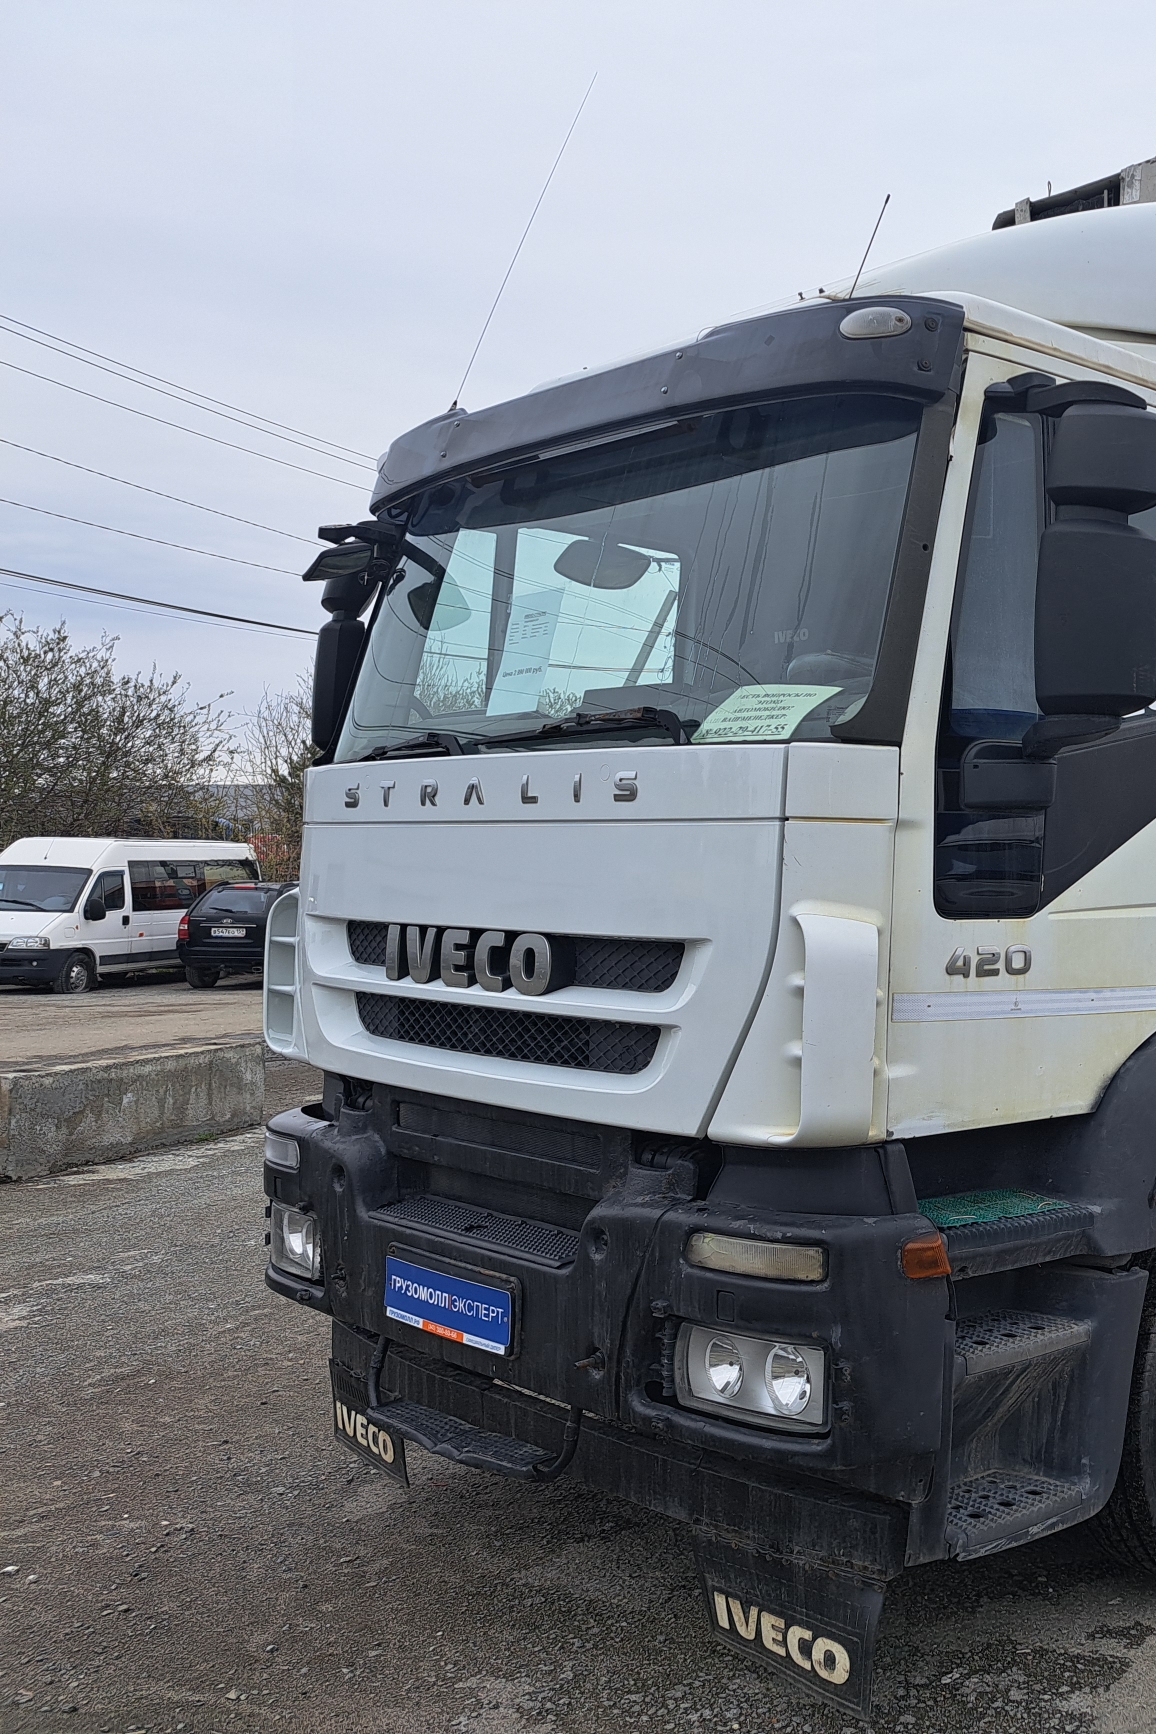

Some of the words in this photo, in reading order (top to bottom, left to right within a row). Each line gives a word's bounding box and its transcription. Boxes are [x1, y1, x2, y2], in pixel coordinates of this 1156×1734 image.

[344, 770, 639, 808] STRALIS
[386, 924, 552, 997] IVECO
[945, 944, 1032, 979] 420
[335, 1400, 395, 1464] IVECO
[713, 1591, 851, 1685] IVECO
